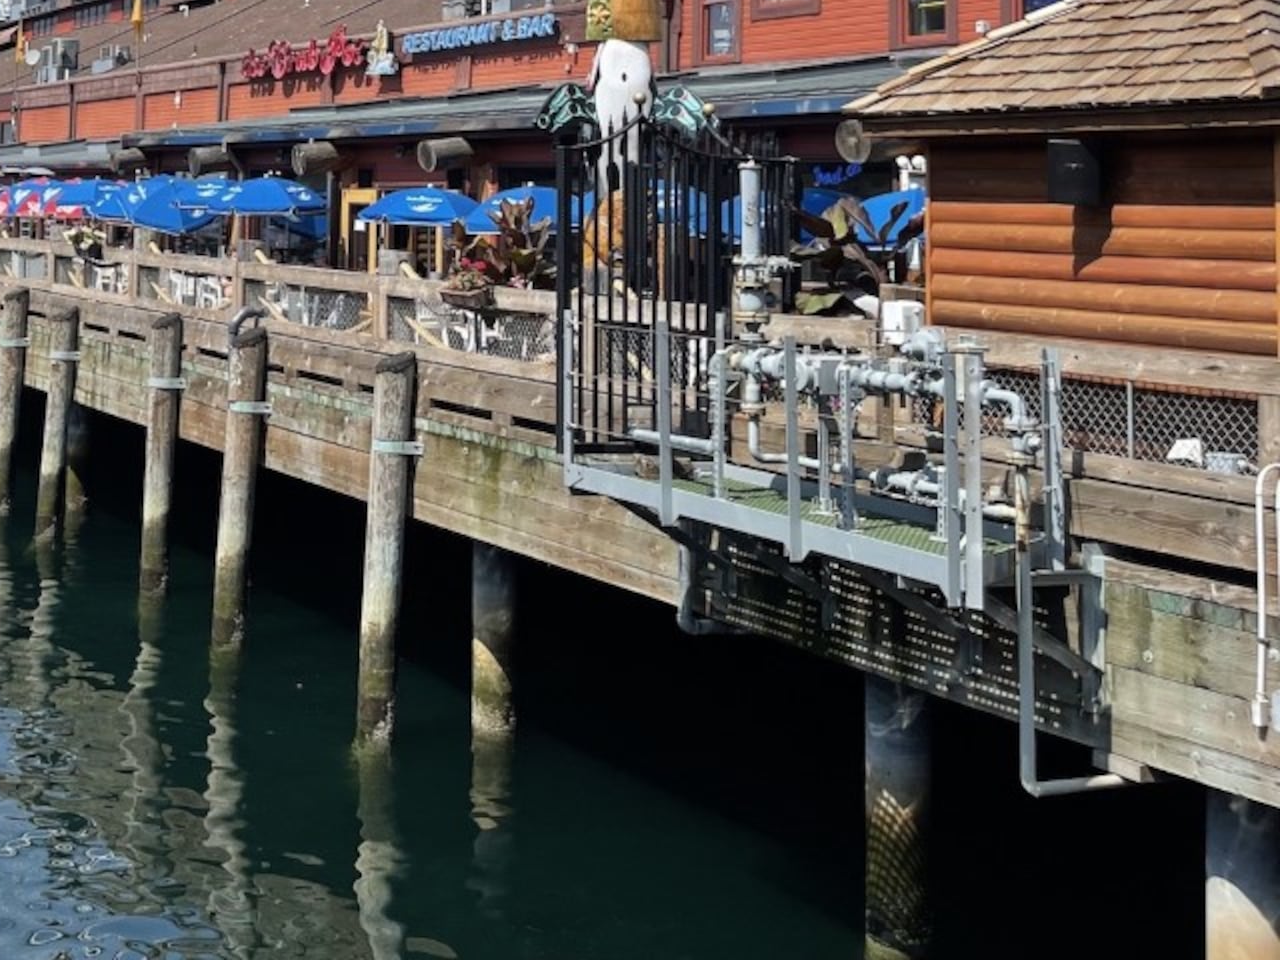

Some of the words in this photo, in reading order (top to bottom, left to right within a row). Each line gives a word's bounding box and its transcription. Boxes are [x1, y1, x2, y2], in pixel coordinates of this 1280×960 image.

[402, 20, 500, 55] RESTAURANT
[501, 18, 517, 41] &
[517, 12, 556, 39] BAR
